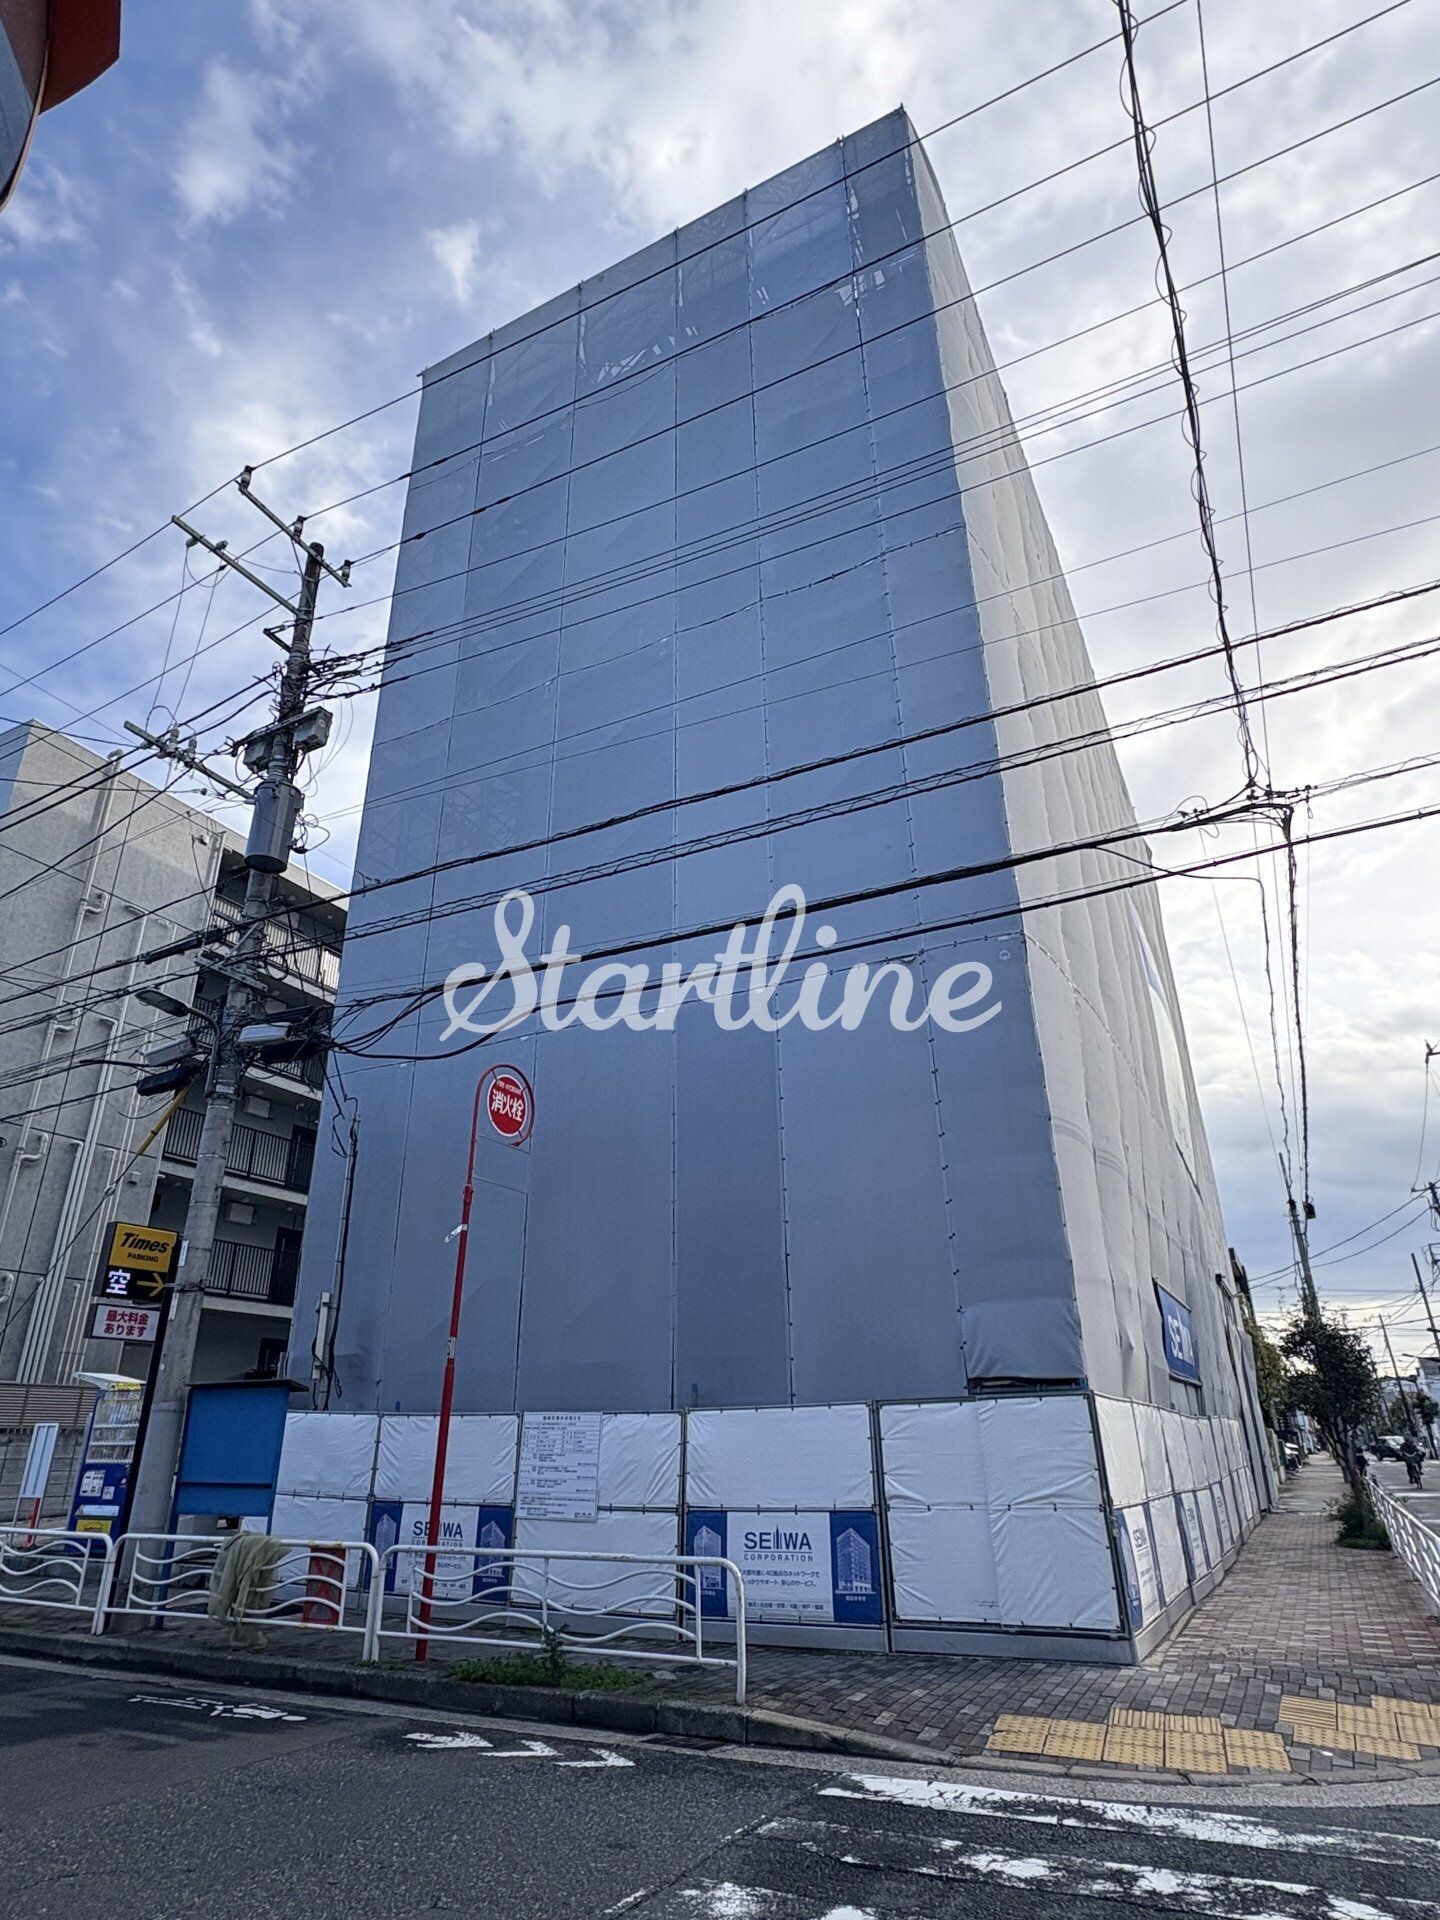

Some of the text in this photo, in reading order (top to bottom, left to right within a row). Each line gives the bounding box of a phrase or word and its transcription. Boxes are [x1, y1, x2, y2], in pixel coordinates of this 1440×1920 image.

[491, 1088, 525, 1122] 消火栓
[120, 1232, 170, 1254] Times
[126, 1252, 159, 1263] PARKING
[105, 1268, 131, 1295] 空
[105, 1309, 149, 1326] 最大料金
[104, 1323, 148, 1337] あります
[744, 1524, 813, 1551] SEIWA
[743, 1553, 814, 1562] CORPORATION
